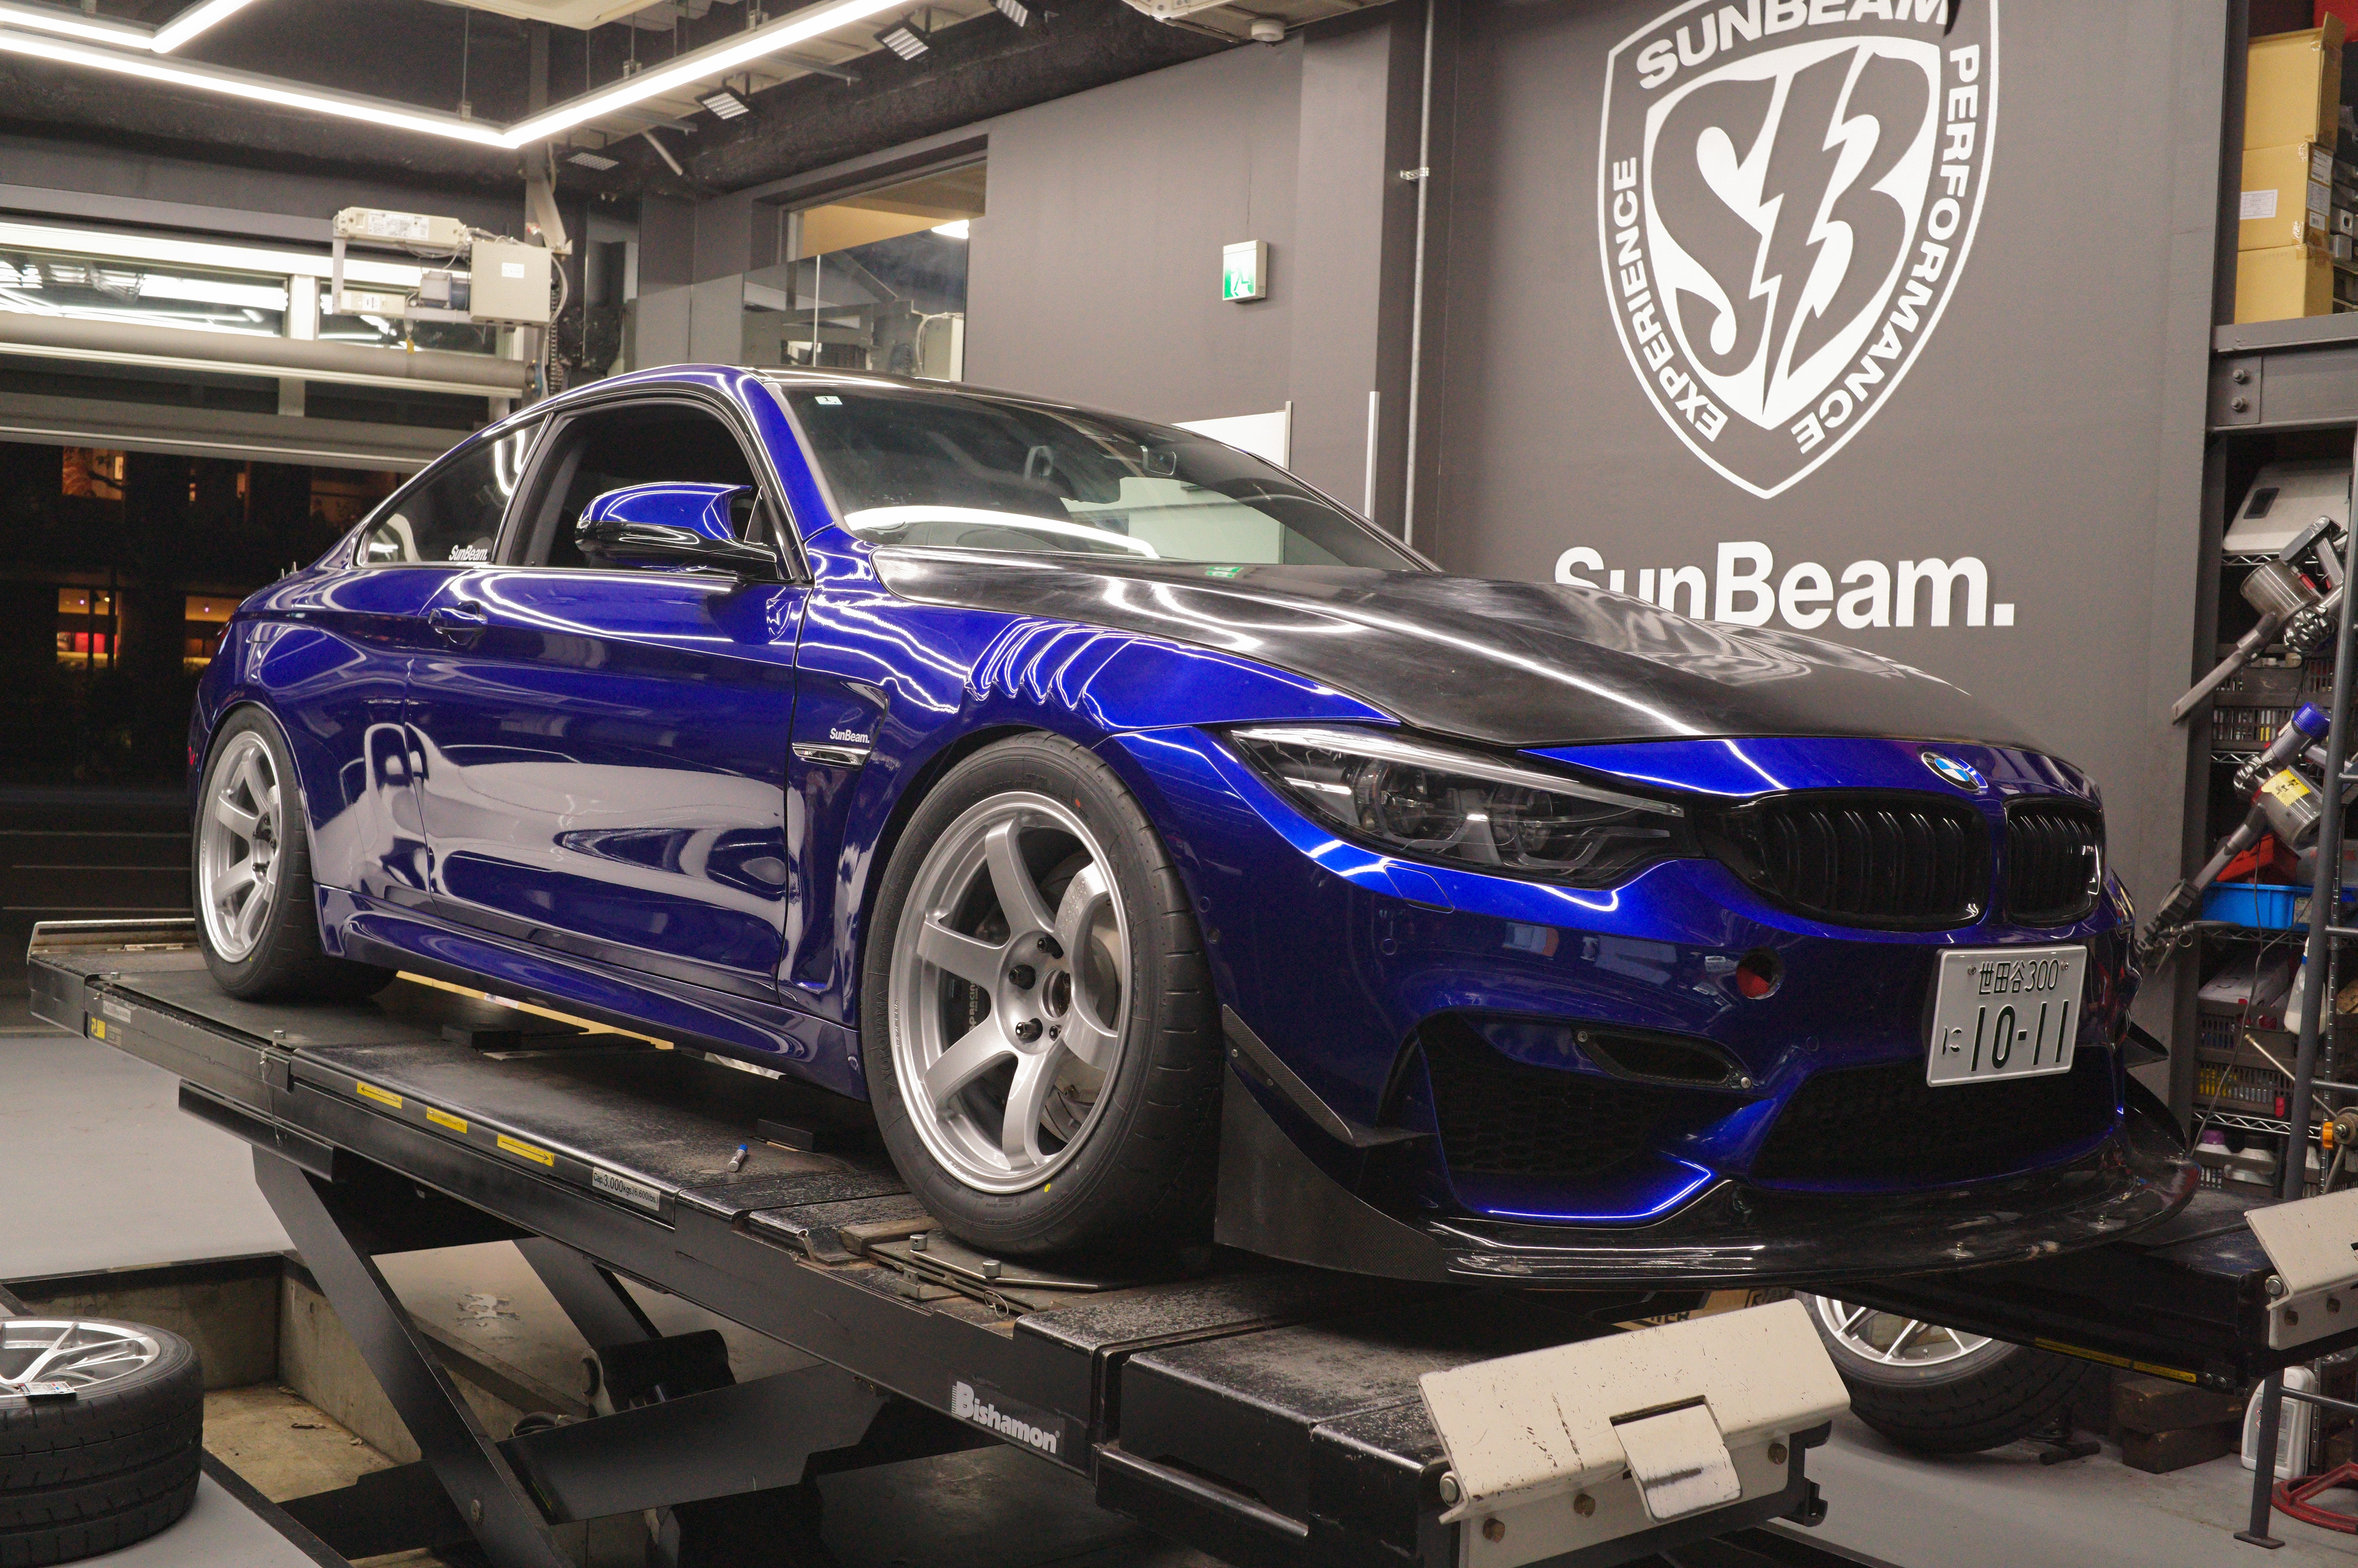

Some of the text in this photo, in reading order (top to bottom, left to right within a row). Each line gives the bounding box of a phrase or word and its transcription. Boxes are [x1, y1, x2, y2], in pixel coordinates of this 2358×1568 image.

[1791, 44, 1980, 454] PERFORMANCE
[1613, 157, 1728, 442] EXPERIENCE
[449, 544, 488, 561] SunBeam.
[830, 728, 870, 744] SunBeam.
[876, 990, 893, 1079] YOKOHAMA
[1942, 1000, 2069, 1071] に 10-11
[951, 1380, 1057, 1454] Bishamon
